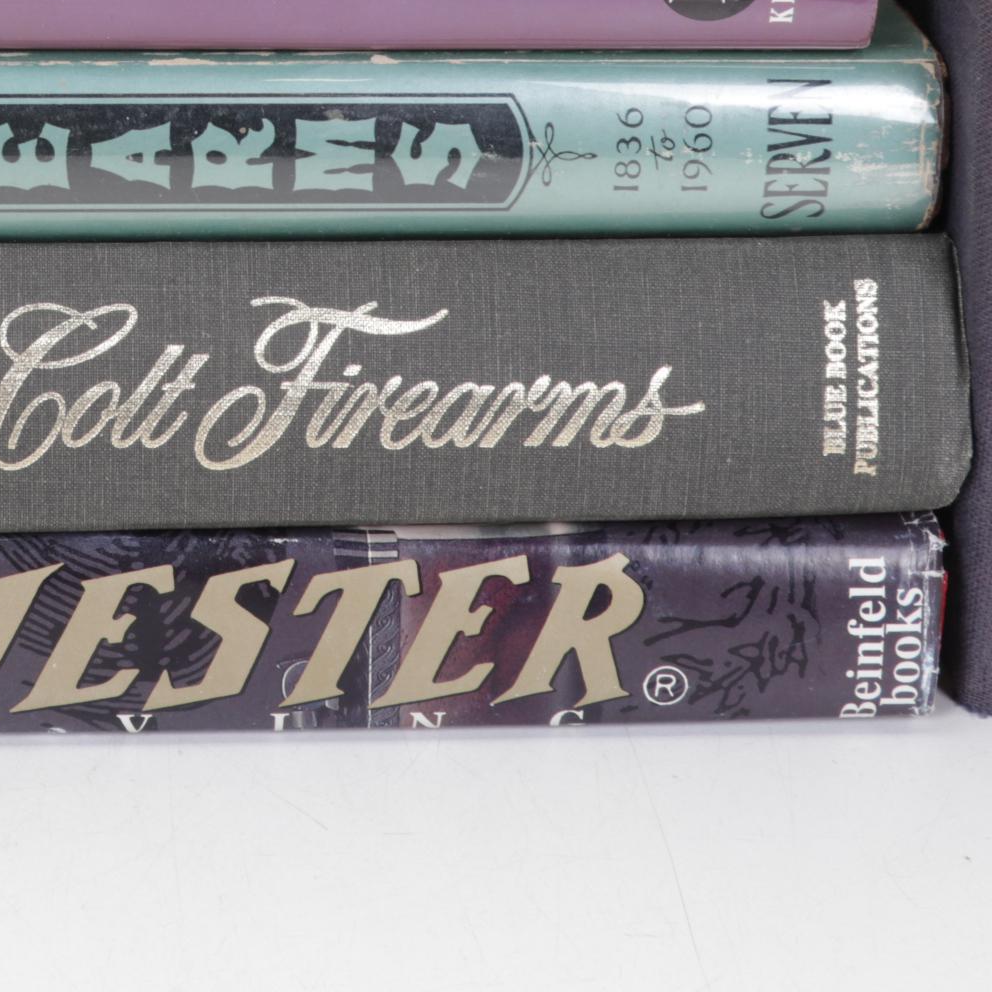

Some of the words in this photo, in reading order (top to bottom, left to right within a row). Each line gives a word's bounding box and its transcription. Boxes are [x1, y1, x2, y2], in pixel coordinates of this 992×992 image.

[613, 107, 644, 192] 1836
[648, 129, 676, 170] to
[680, 105, 713, 192] 1960
[760, 78, 833, 220] SERVEN
[193, 296, 705, 470] Firearms
[823, 299, 847, 380] BOOK
[853, 277, 879, 478] PUBLICATIONS
[823, 384, 848, 457] BLUE
[838, 555, 888, 720] Beinfeld
[880, 587, 924, 707] books
